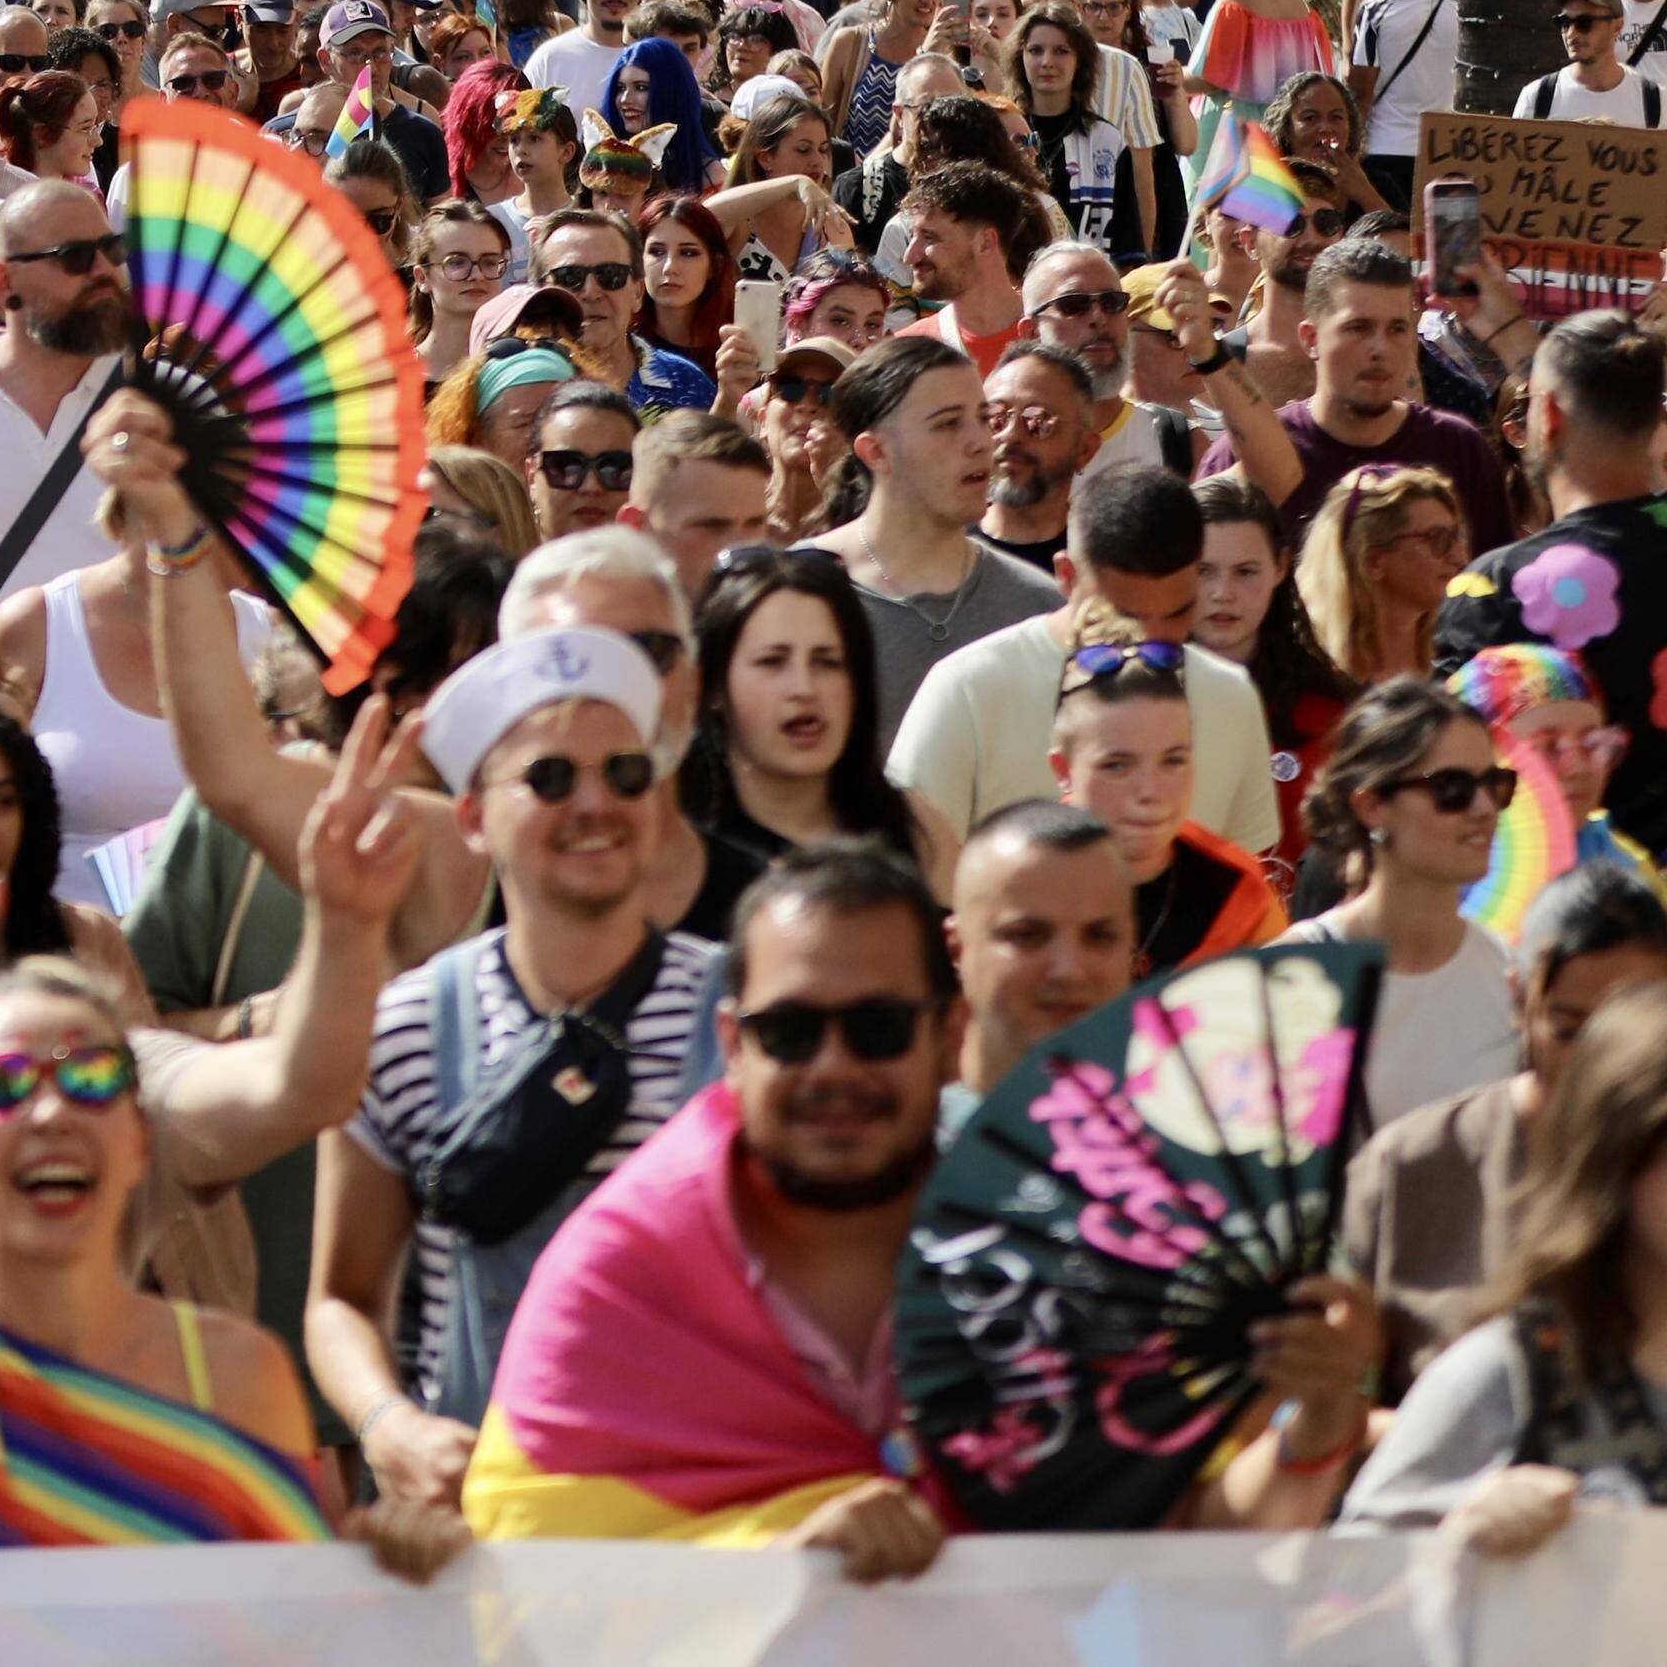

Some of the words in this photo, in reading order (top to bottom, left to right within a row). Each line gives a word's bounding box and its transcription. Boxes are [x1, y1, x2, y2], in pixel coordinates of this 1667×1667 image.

[1586, 139, 1660, 177] VOUS
[1509, 164, 1612, 208] MÂLE
[1480, 206, 1645, 248] VENEZ
